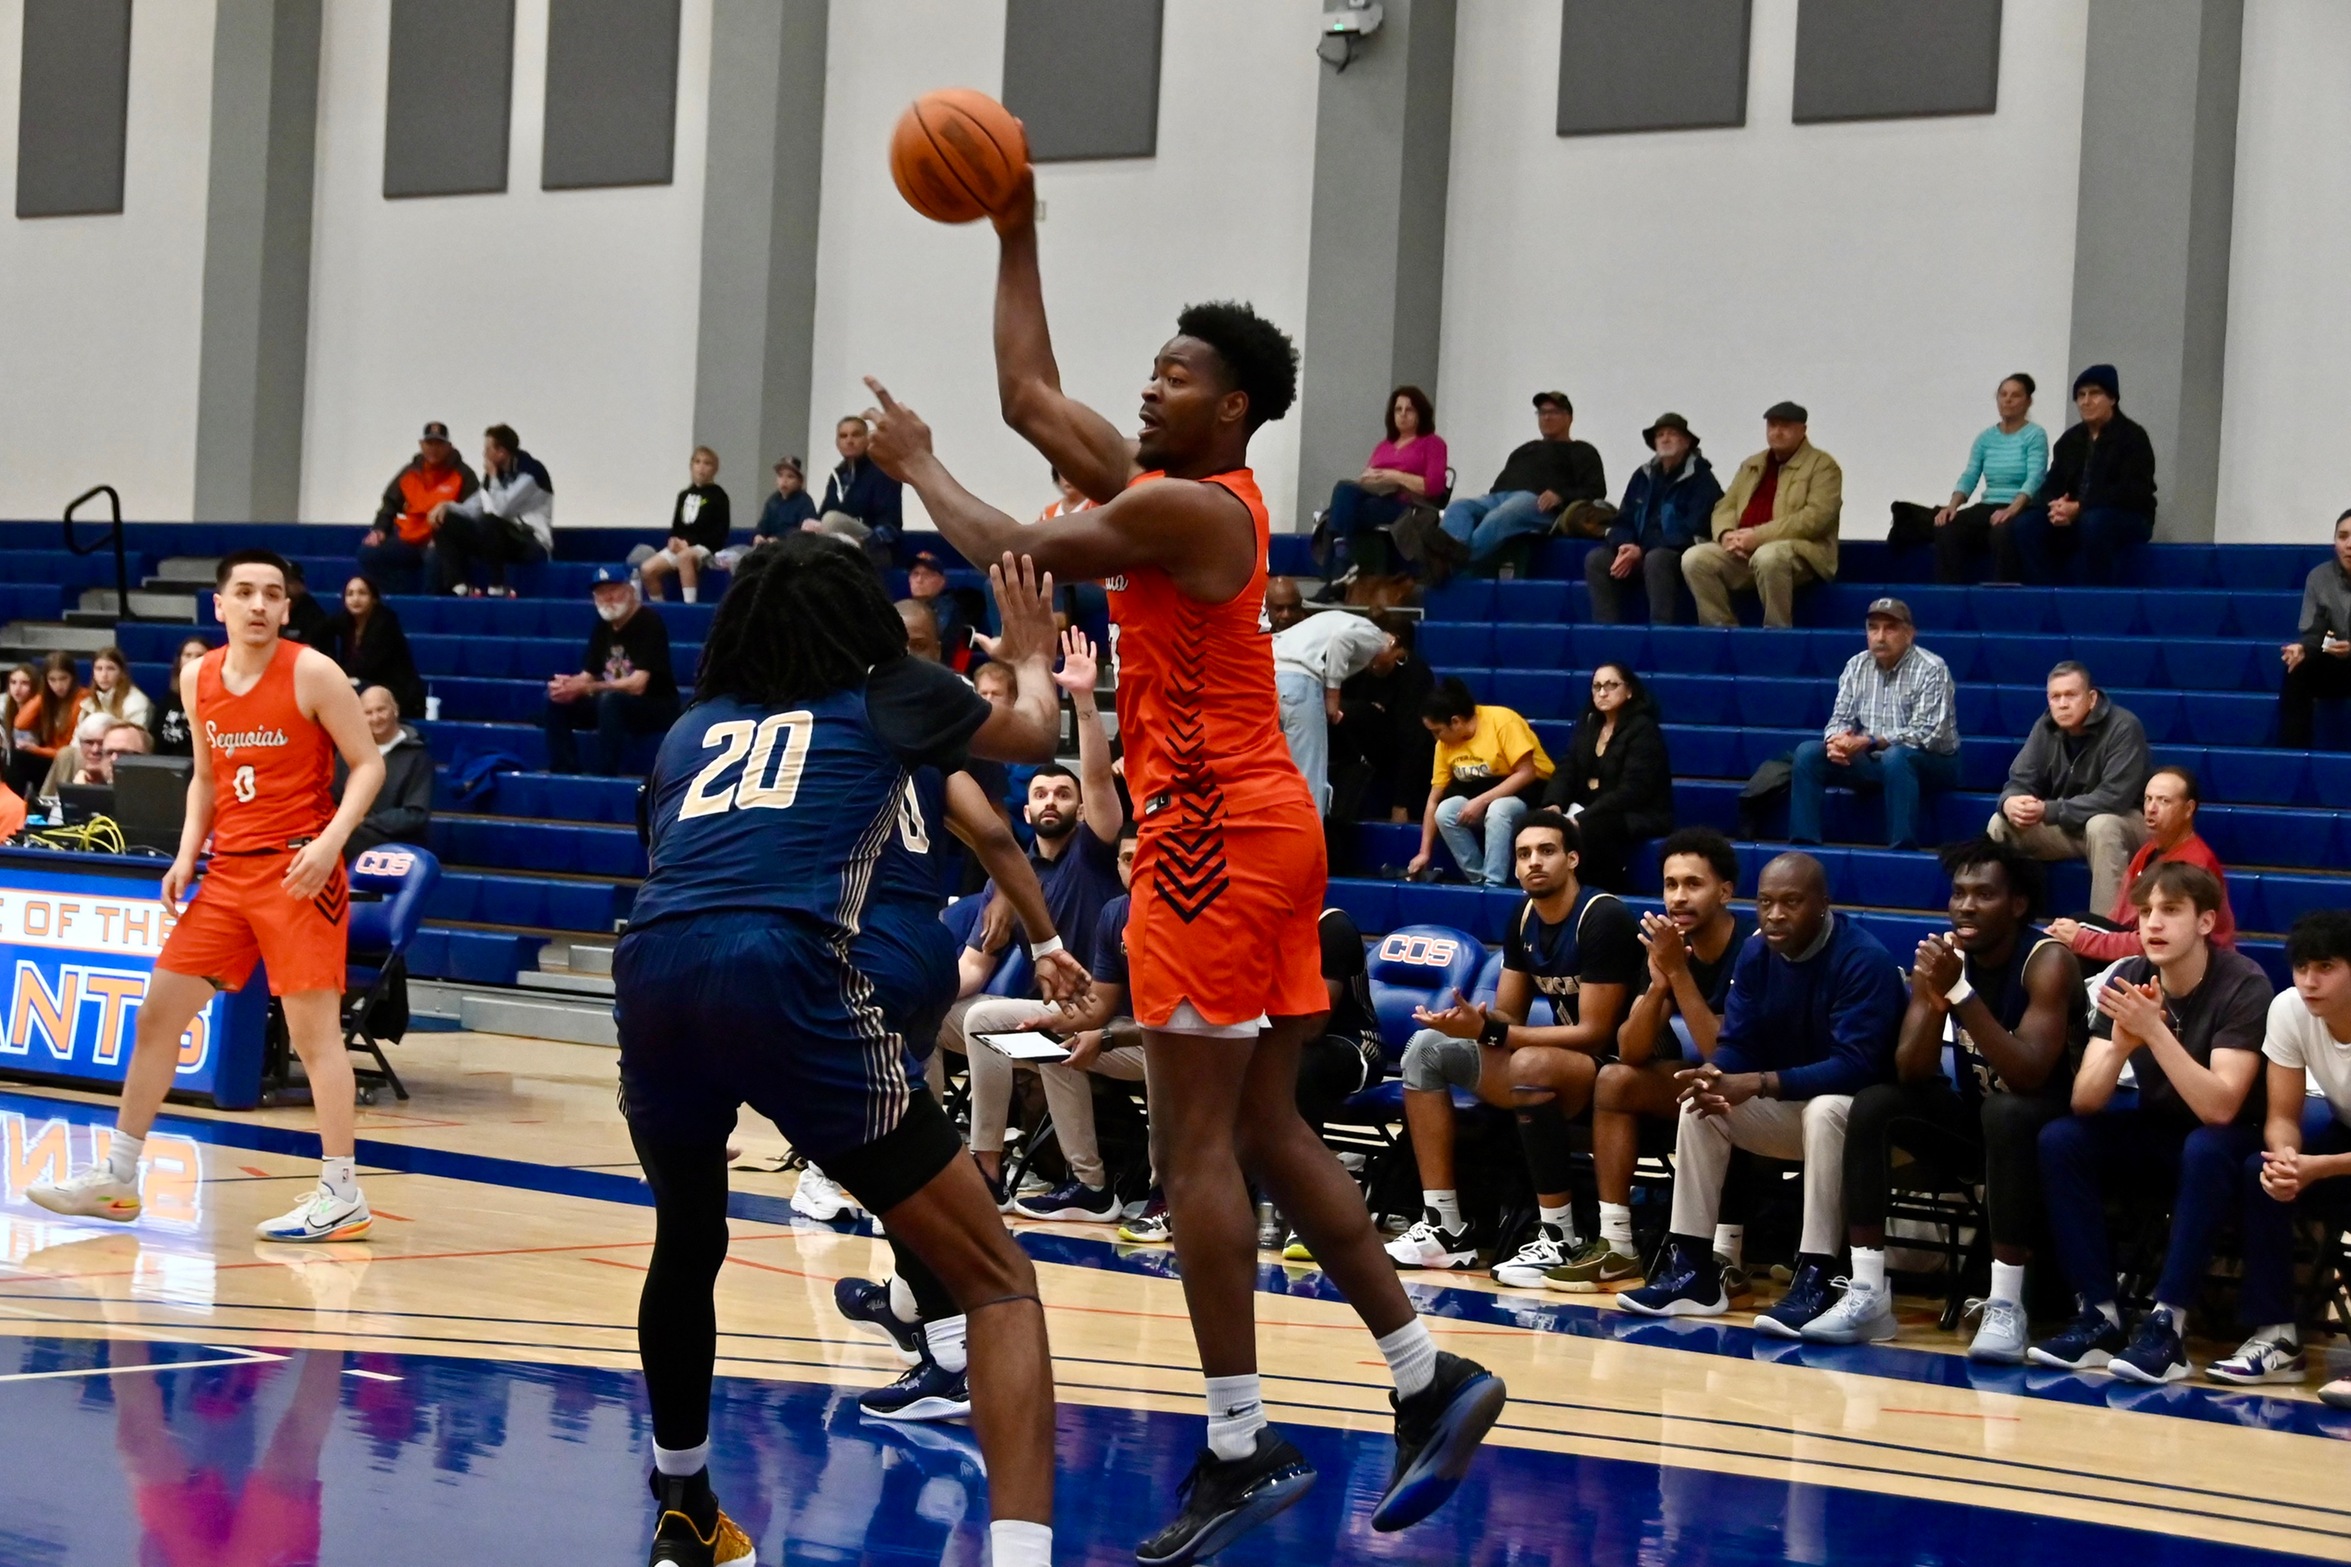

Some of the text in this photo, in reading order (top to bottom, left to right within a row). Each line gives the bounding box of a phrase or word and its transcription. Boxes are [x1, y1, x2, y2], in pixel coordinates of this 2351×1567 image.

[205, 719, 288, 759] Sequoias
[232, 765, 256, 803] 0
[678, 710, 814, 821] 20
[355, 850, 415, 877] COS
[24, 901, 80, 938] OF
[94, 906, 178, 948] THE
[1379, 934, 1458, 967] COS
[0, 959, 211, 1074] NT
